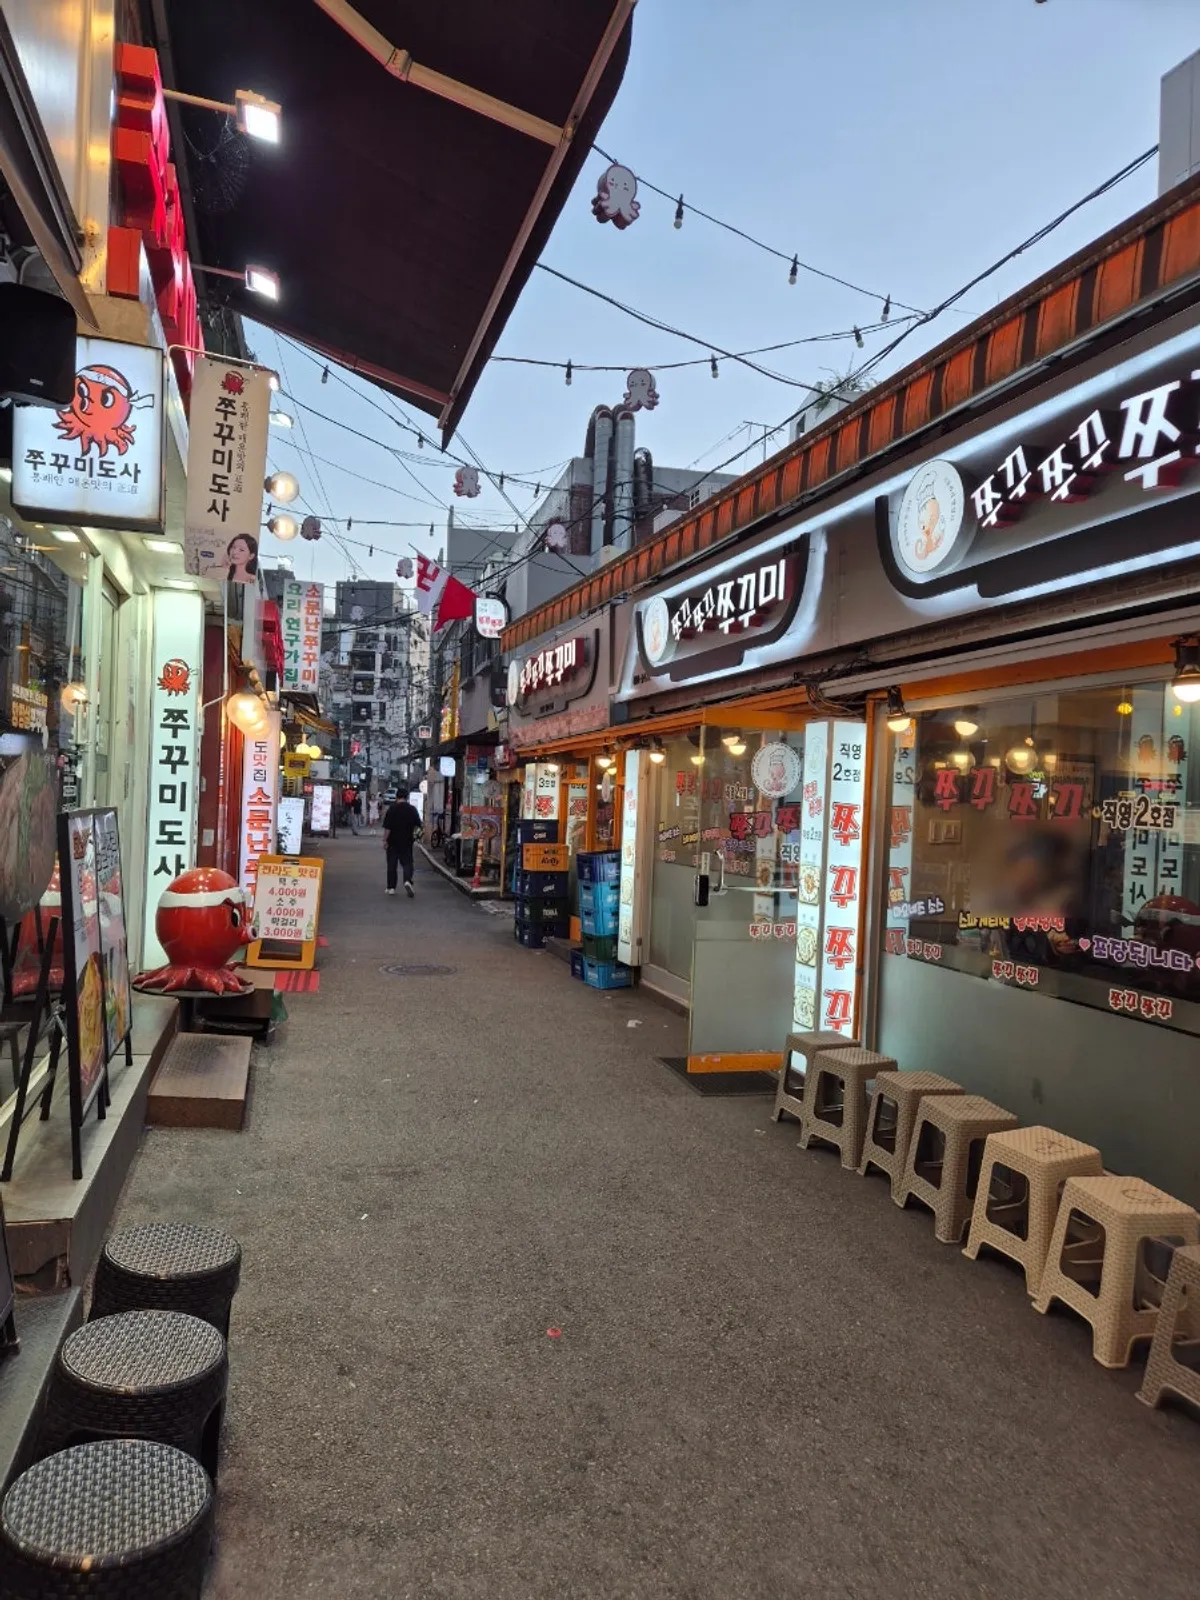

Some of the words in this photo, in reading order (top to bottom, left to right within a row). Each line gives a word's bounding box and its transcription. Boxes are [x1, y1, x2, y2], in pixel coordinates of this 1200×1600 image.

[1118, 369, 1200, 490] 쭈
[24, 449, 141, 484] 쭈꾸미도사
[207, 396, 237, 522] 쭈꾸미도사
[840, 743, 861, 760] 직영
[833, 762, 861, 782] 2호점
[153, 707, 190, 878] 쭈꾸미도사
[1092, 935, 1194, 972] 포장됩니다
